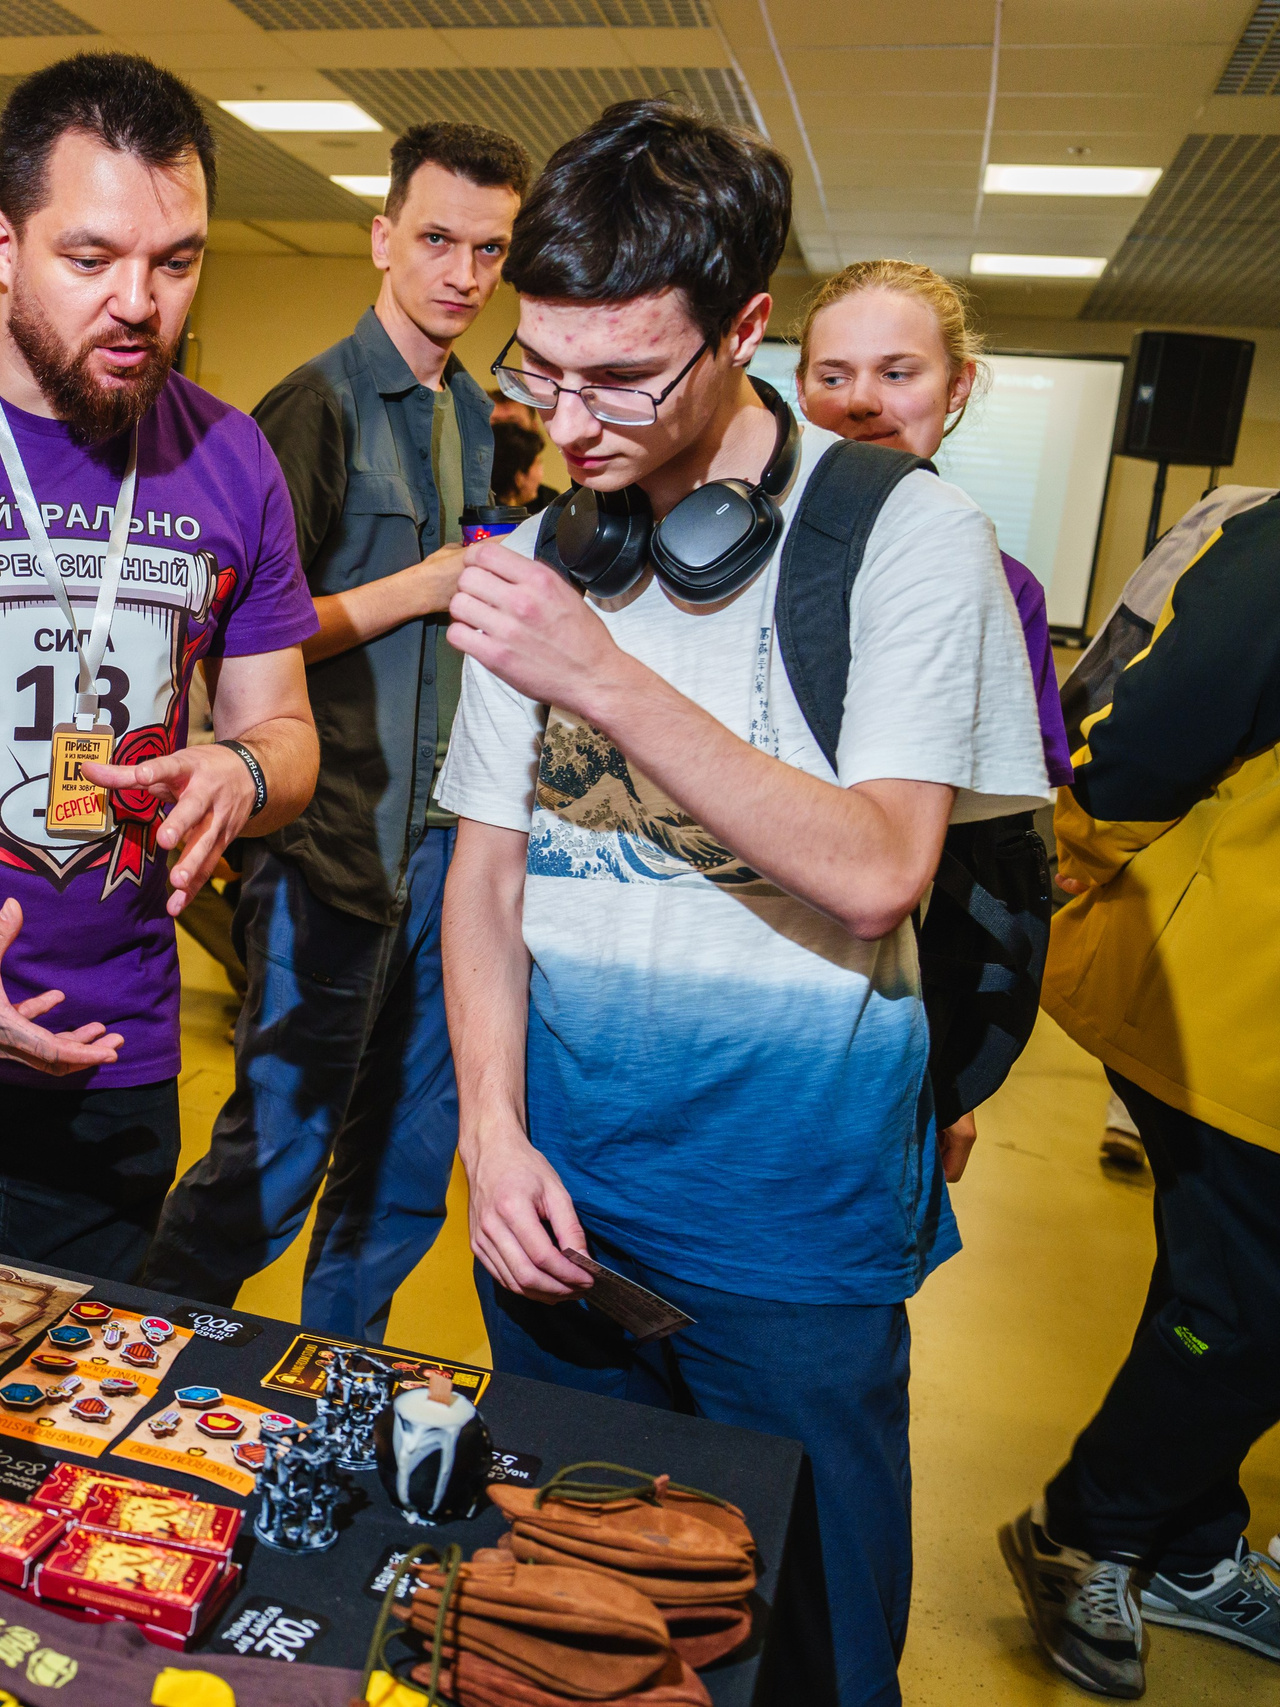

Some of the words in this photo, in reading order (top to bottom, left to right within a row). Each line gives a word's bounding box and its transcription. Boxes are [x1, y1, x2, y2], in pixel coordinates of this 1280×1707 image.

[65, 741, 101, 752] ПРИВЕТ!
[63, 761, 84, 781] LR
[55, 792, 102, 822] СЕРГЕЙ
[113, 1368, 148, 1385] LIVING
[18, 1420, 56, 1438] ROOM
[56, 1430, 95, 1448] LIVING
[129, 1445, 170, 1461] STUDIO
[170, 1455, 206, 1471] ROOM
[206, 1467, 244, 1485] LIVING
